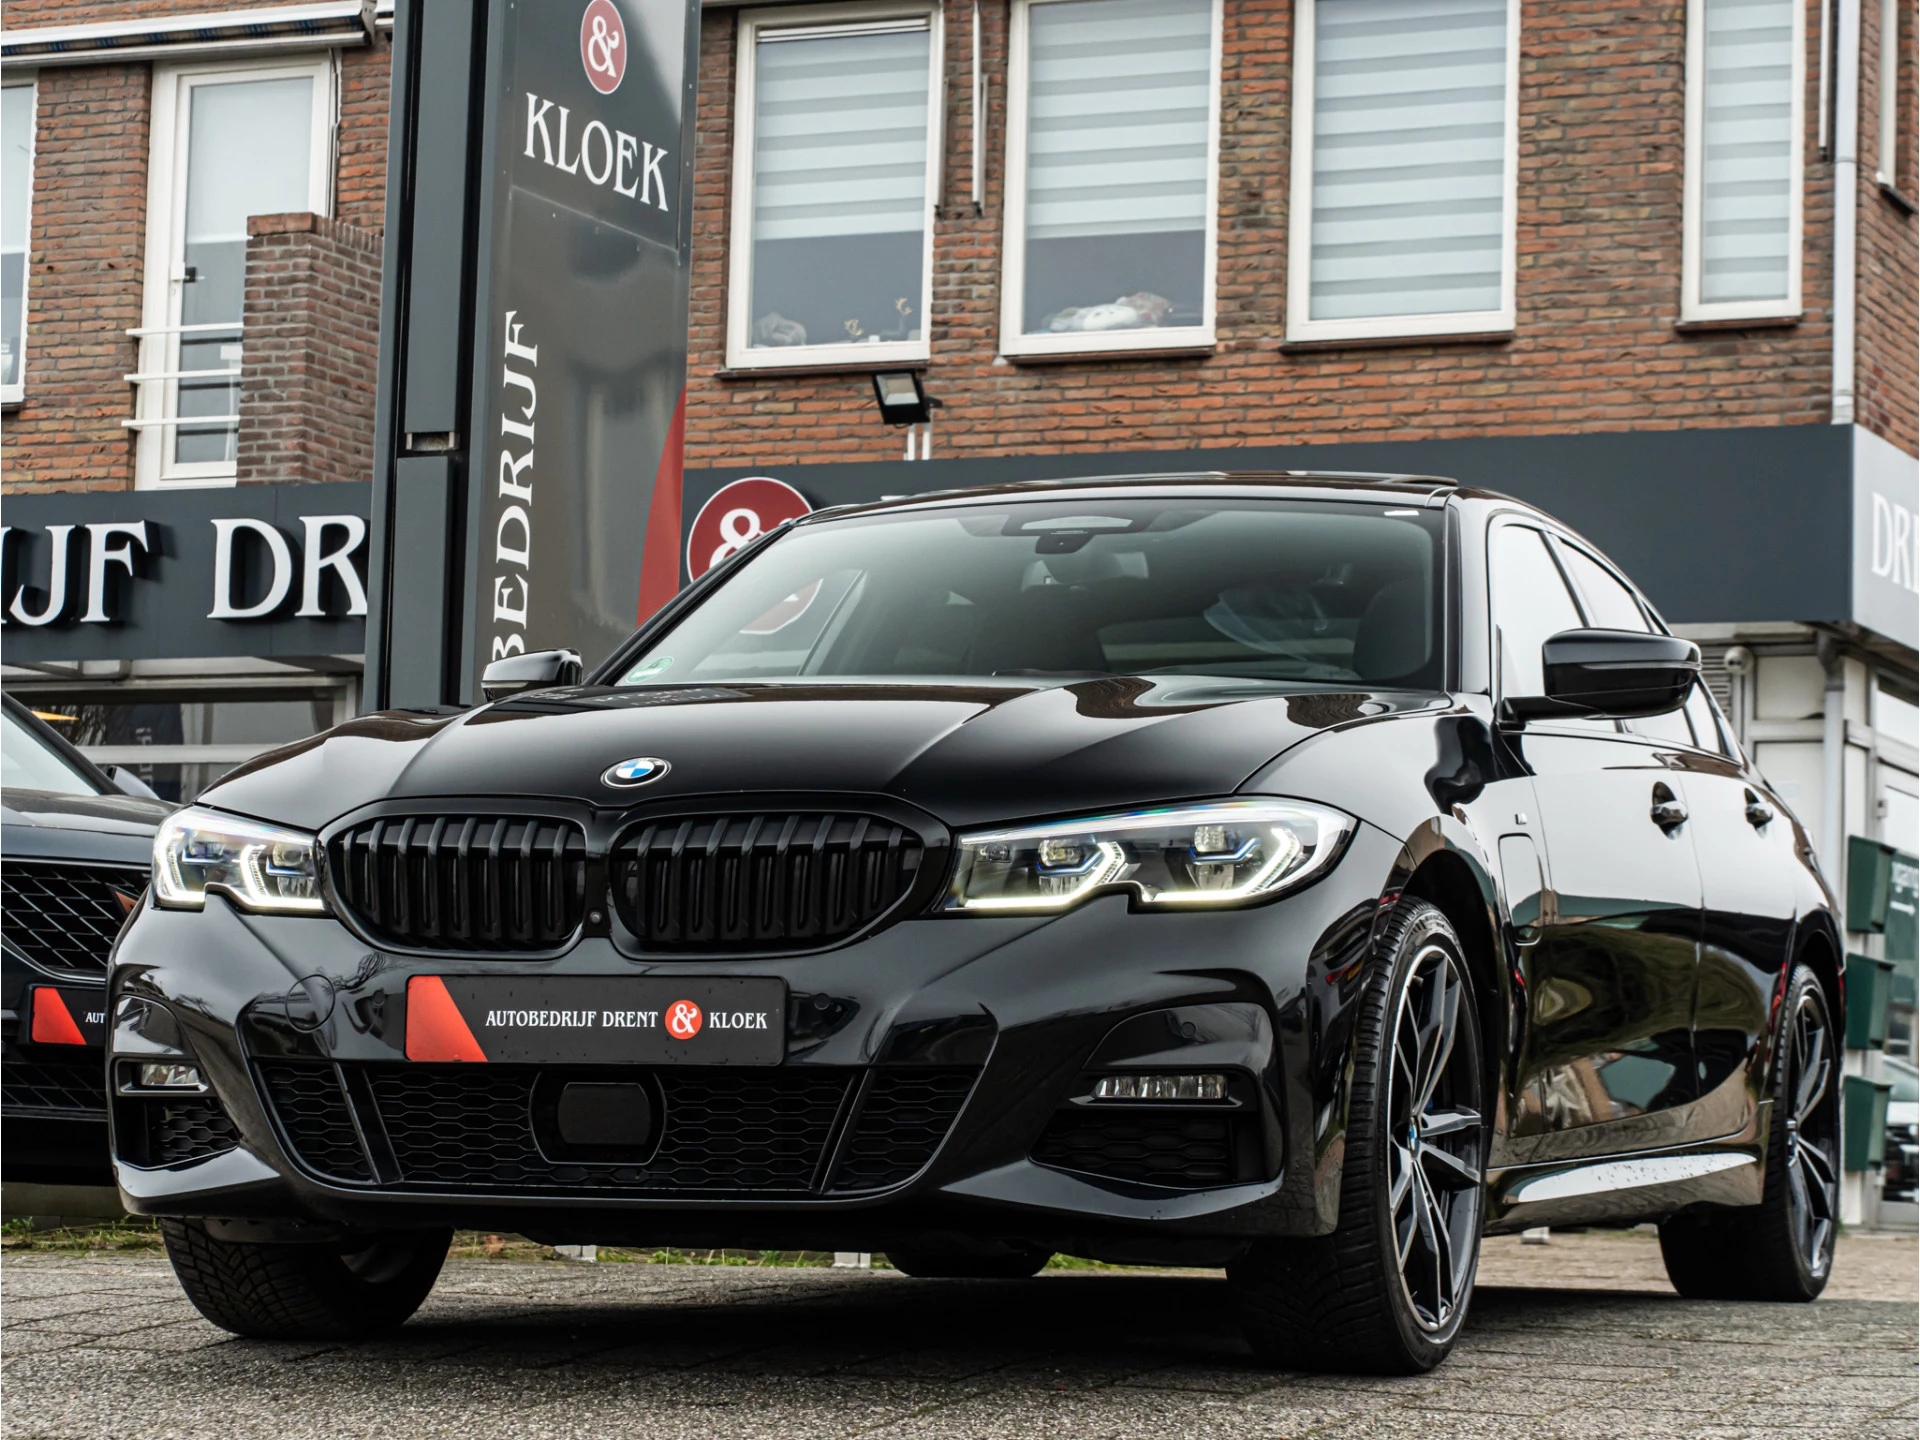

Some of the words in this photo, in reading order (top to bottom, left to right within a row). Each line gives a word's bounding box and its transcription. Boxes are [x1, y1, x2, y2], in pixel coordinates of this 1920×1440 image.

[587, 14, 621, 79] &
[523, 92, 669, 212] KLOEK
[206, 515, 368, 618] DR
[85, 1011, 106, 1024] AUT
[485, 1010, 597, 1028] AUTOBEDRIJF
[602, 1010, 659, 1028] DRENT
[671, 1003, 698, 1034] &
[709, 1012, 768, 1030] KLOEK
